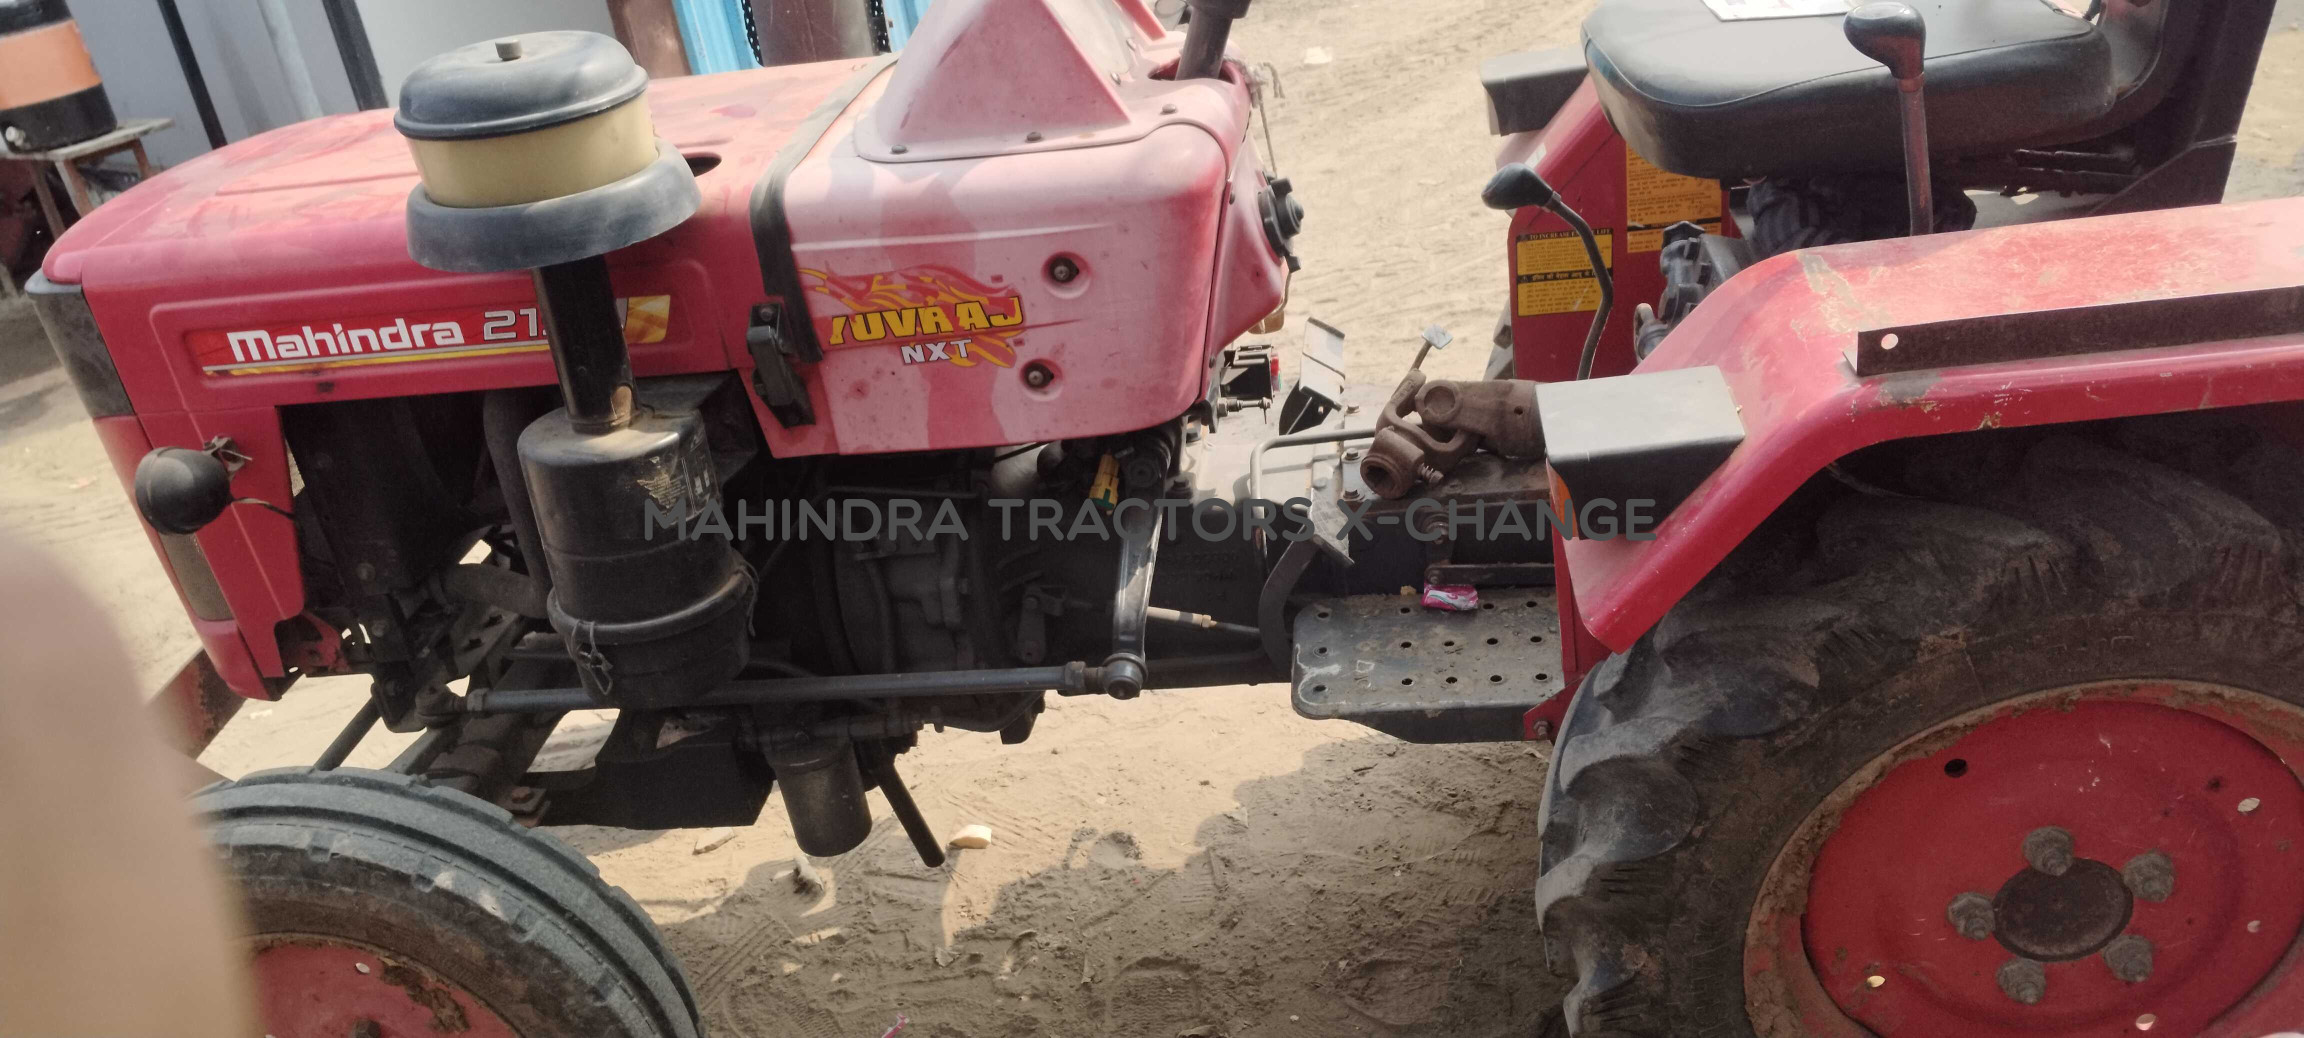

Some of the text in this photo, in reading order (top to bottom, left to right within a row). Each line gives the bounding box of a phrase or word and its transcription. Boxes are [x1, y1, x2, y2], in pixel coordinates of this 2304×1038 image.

[226, 307, 548, 363] Mahindra 21
[900, 338, 972, 365] NXT
